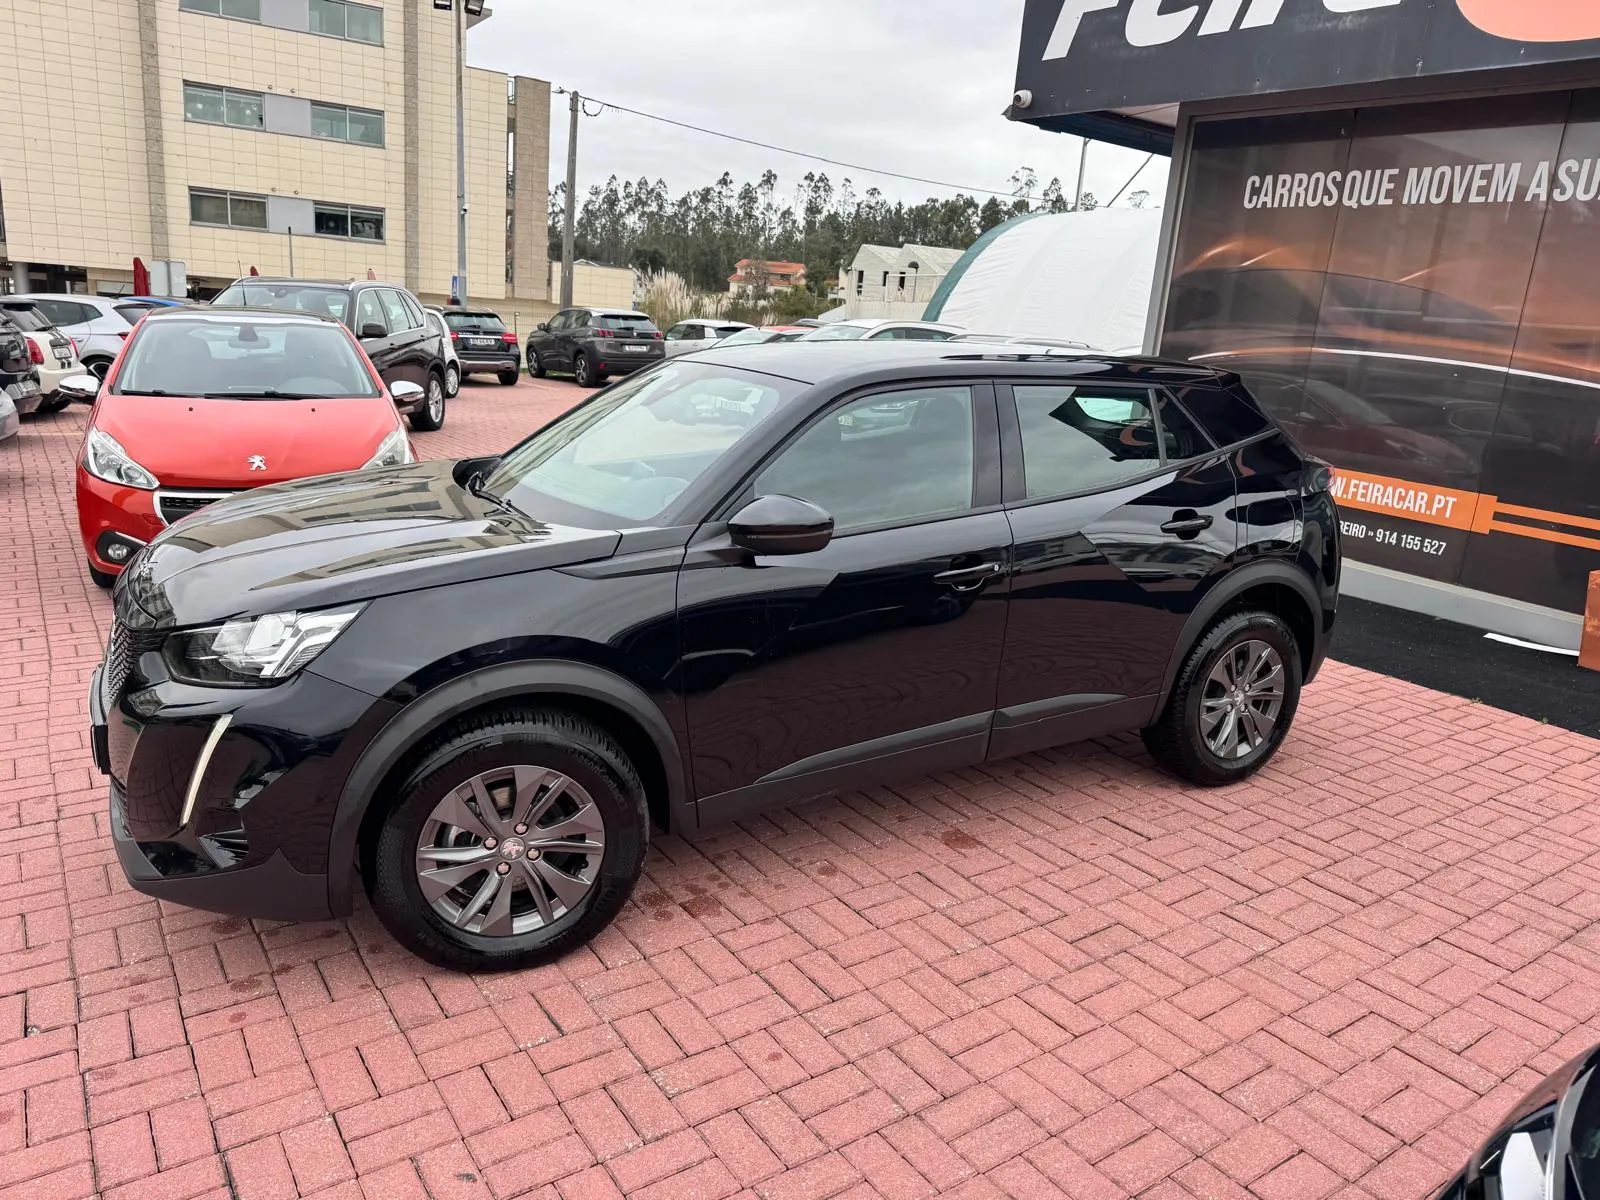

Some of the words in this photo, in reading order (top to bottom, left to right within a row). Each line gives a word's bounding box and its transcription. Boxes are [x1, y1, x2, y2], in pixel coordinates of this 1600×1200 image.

[1243, 170, 1342, 209] CARROS
[1342, 168, 1399, 209] QUE
[1402, 162, 1522, 204] MOVEM
[1552, 158, 1600, 202] SU
[1376, 528, 1398, 546] 914
[1401, 534, 1422, 551] 155
[1423, 538, 1447, 556] 527
